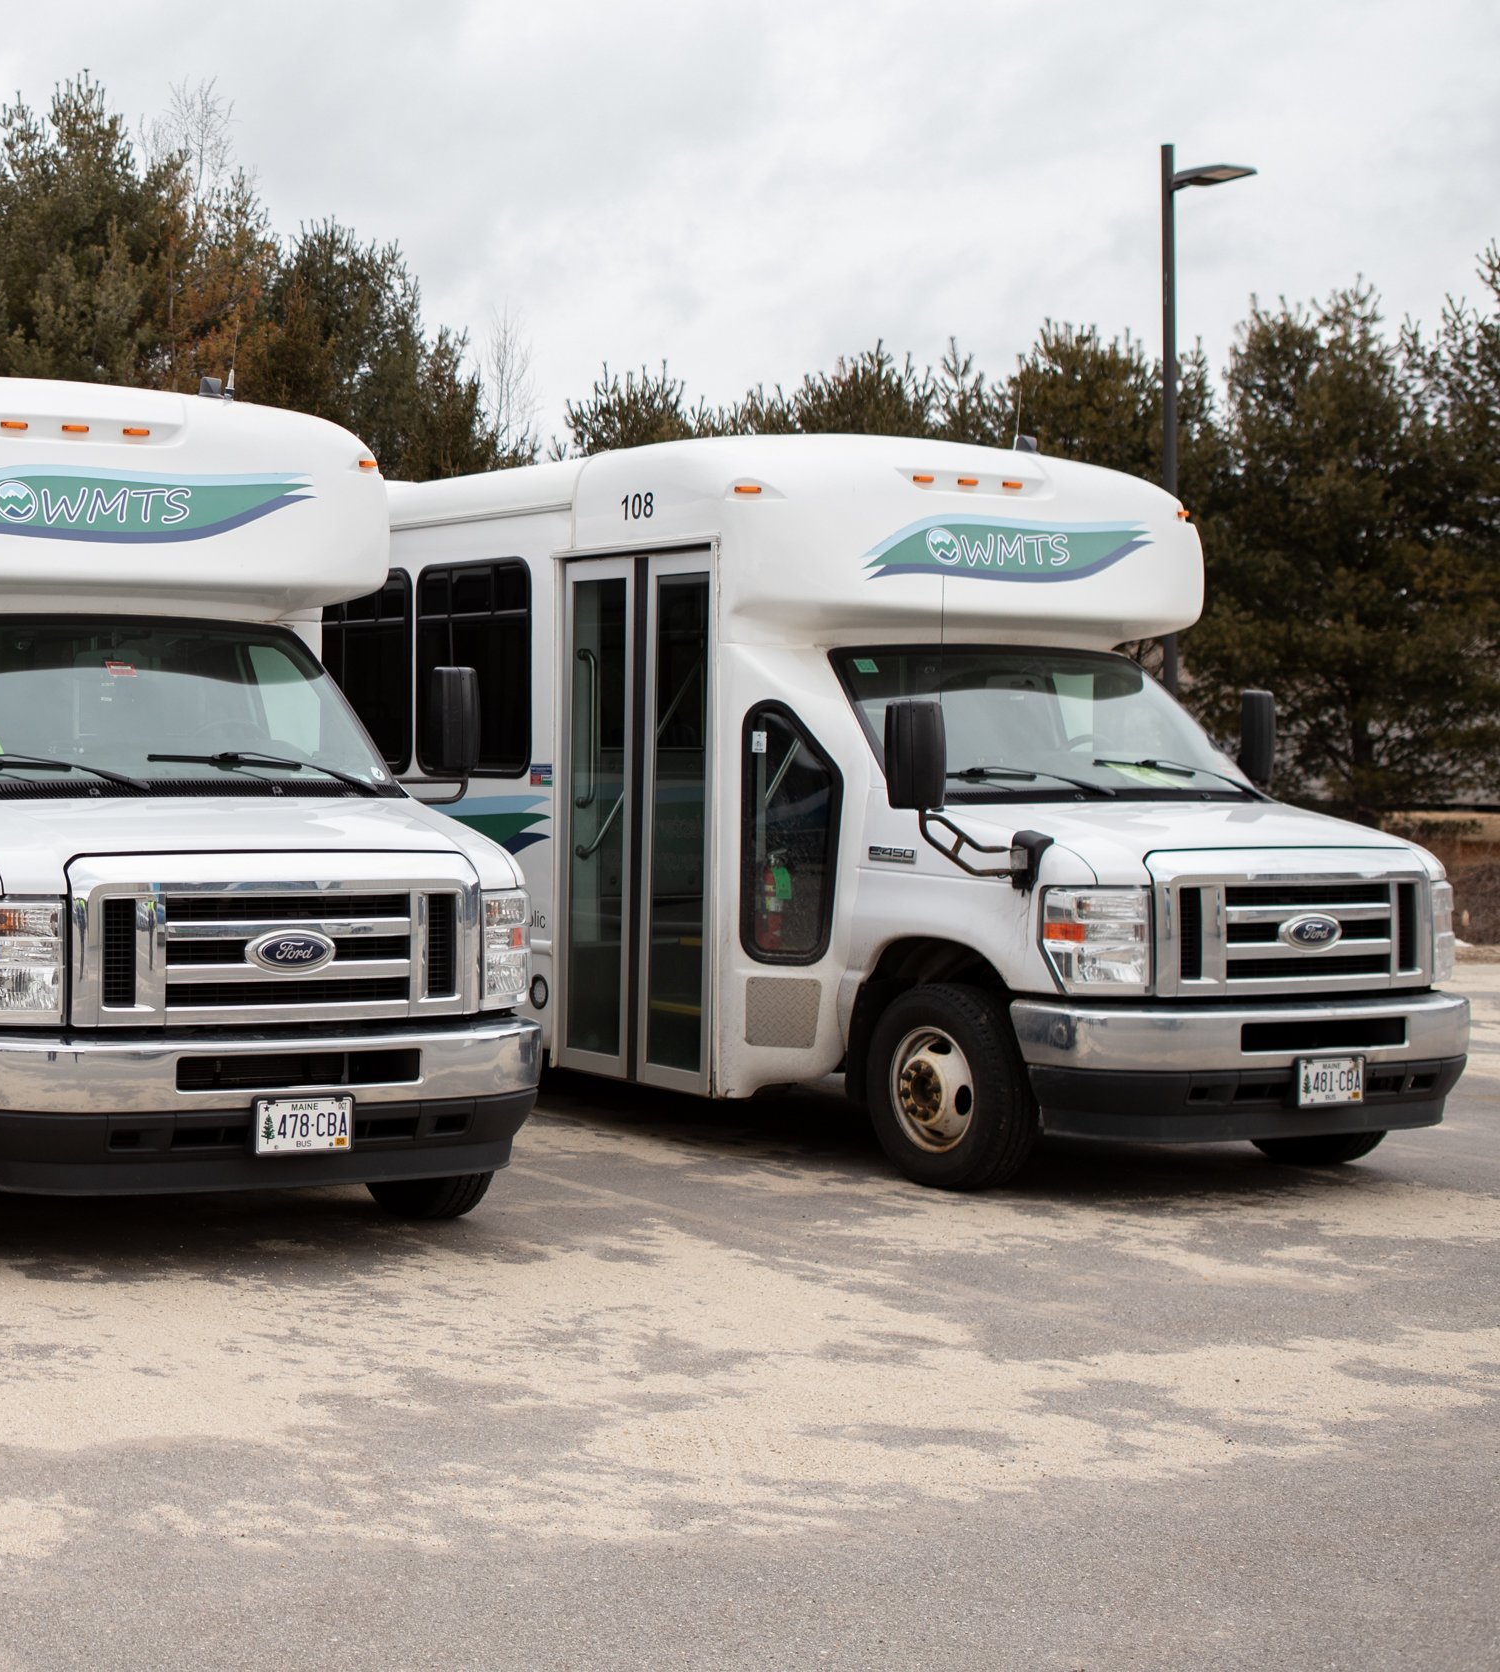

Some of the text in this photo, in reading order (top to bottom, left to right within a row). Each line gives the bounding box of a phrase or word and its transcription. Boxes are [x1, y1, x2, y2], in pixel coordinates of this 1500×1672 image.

[41, 487, 191, 525] WMTS
[621, 491, 654, 520] 108
[960, 533, 1070, 567] WMTS
[1303, 923, 1330, 939] Ford
[275, 941, 314, 960] Ford
[291, 1102, 319, 1111] MAINE
[296, 1140, 312, 1148] BUS
